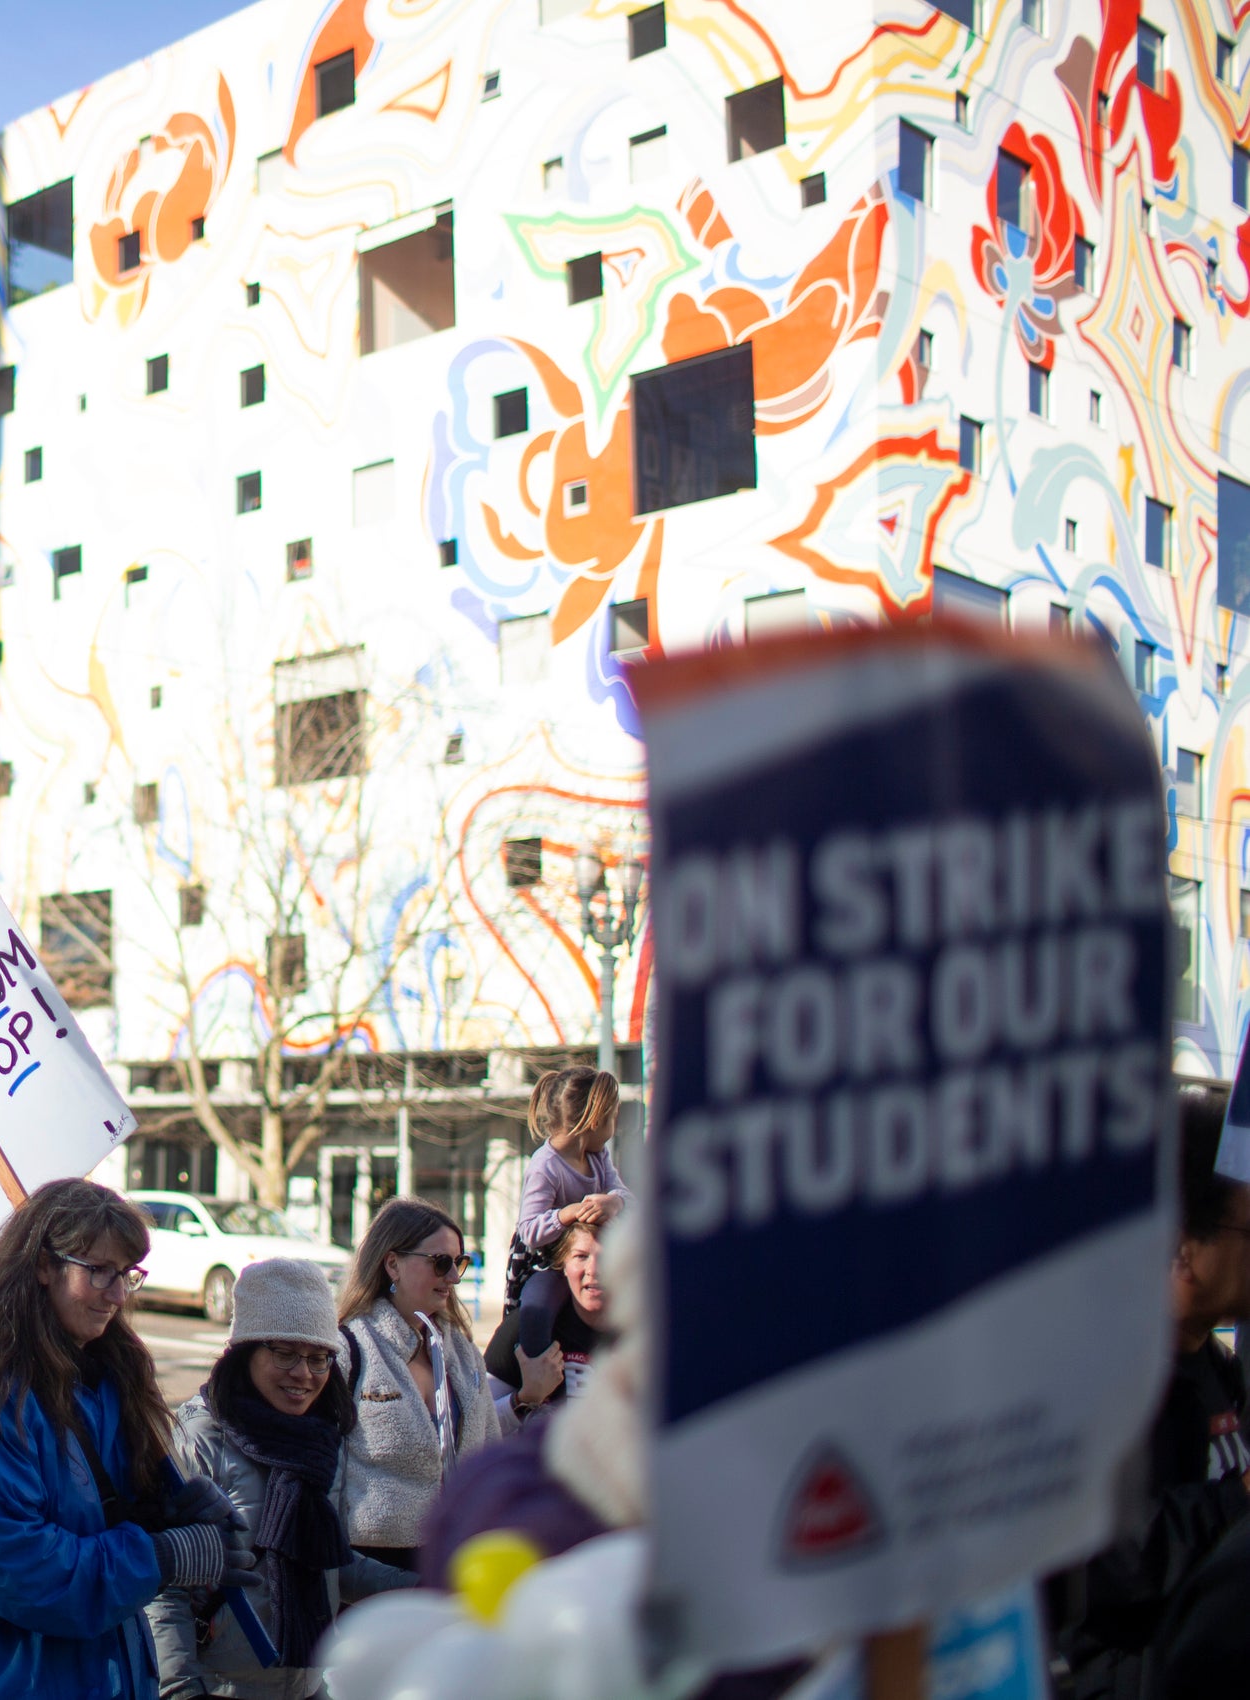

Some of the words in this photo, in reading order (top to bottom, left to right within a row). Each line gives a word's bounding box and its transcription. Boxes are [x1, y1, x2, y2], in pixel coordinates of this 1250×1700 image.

[662, 838, 802, 984] ON
[812, 803, 1156, 955] STRIKE
[705, 955, 922, 1098] FOR
[930, 922, 1139, 1060] OUR
[662, 1038, 1156, 1242] STUDENTS
